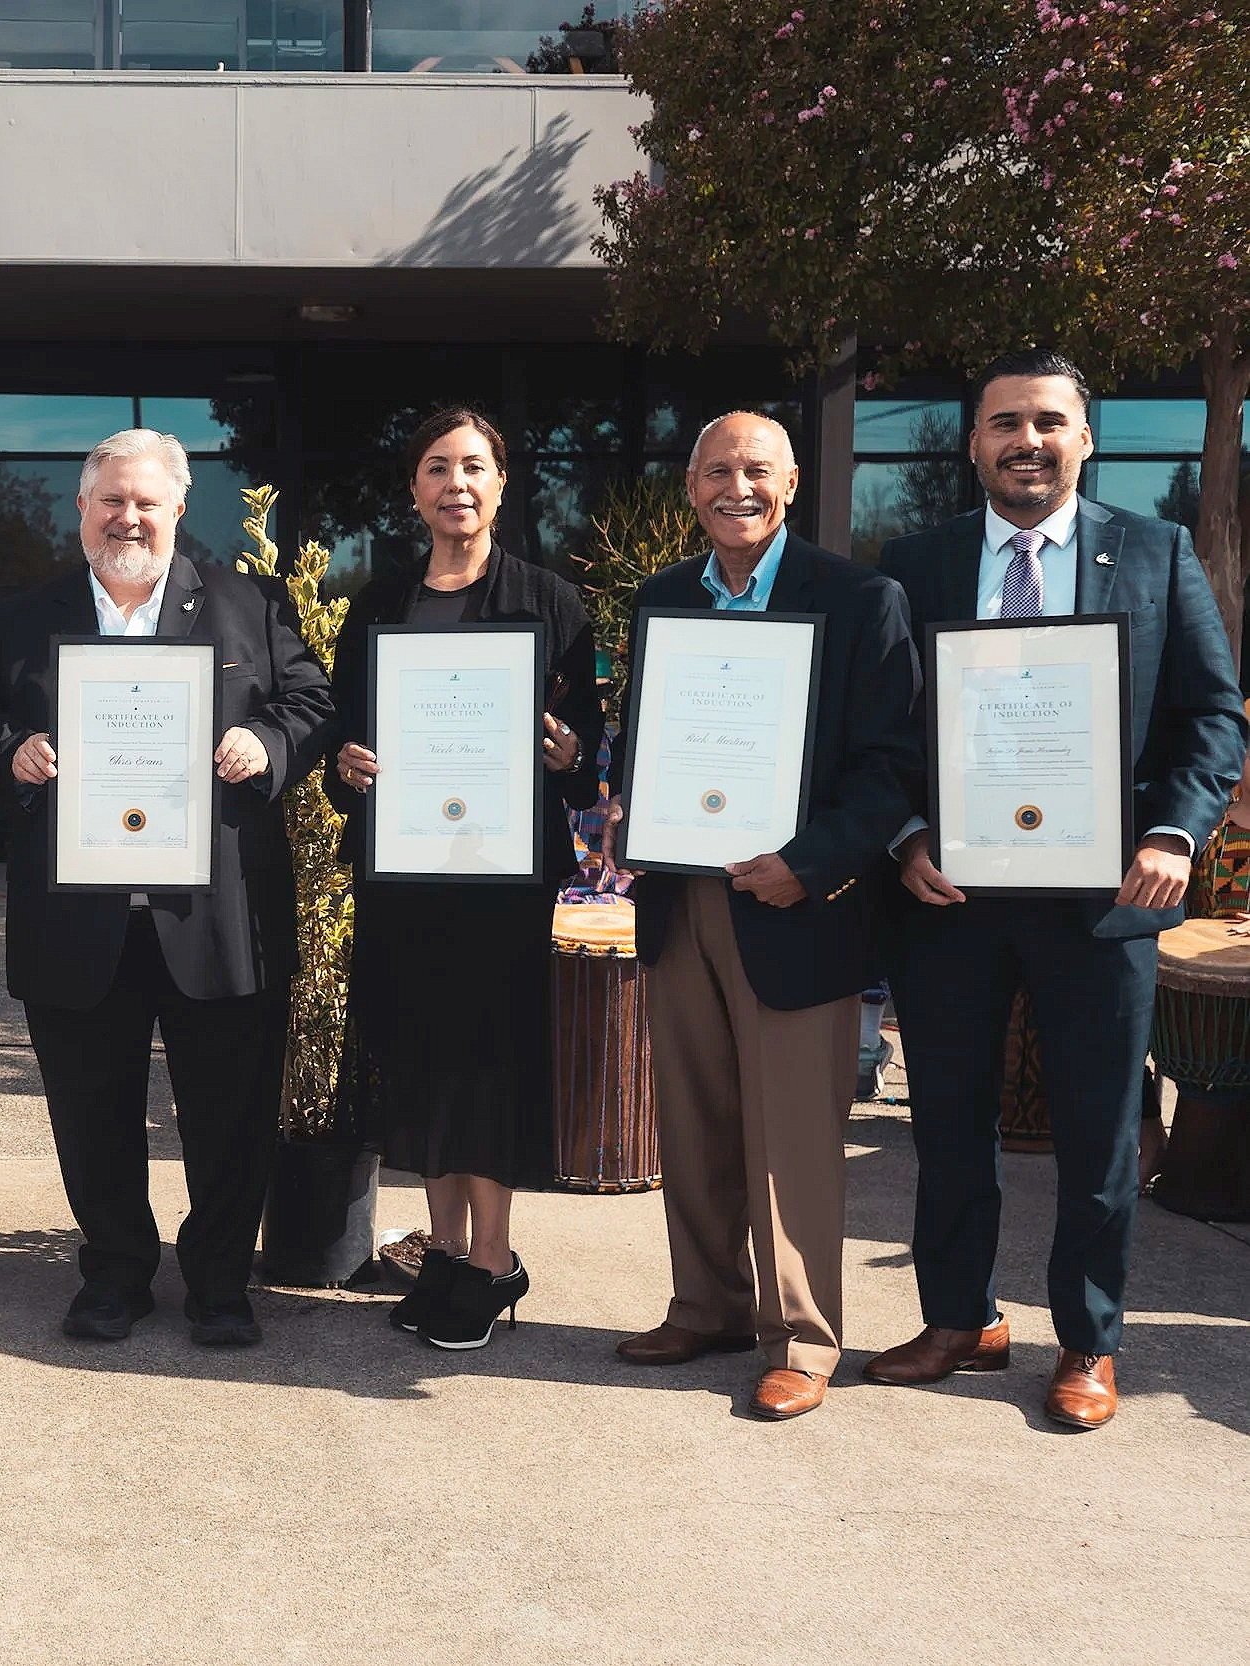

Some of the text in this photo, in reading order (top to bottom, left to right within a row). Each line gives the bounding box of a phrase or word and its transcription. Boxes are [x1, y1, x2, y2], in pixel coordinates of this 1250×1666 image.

[679, 691, 746, 700] CERTIFICATE
[413, 702, 480, 710] CERTIFICATE
[692, 698, 753, 708] INDUCTION
[977, 702, 1054, 711] CERTIFICATE
[94, 713, 175, 721] CERTIFICATE OF
[992, 710, 1060, 719] INDUCTION
[107, 721, 164, 729] INDUCTION
[107, 753, 164, 766] Chris Evans
